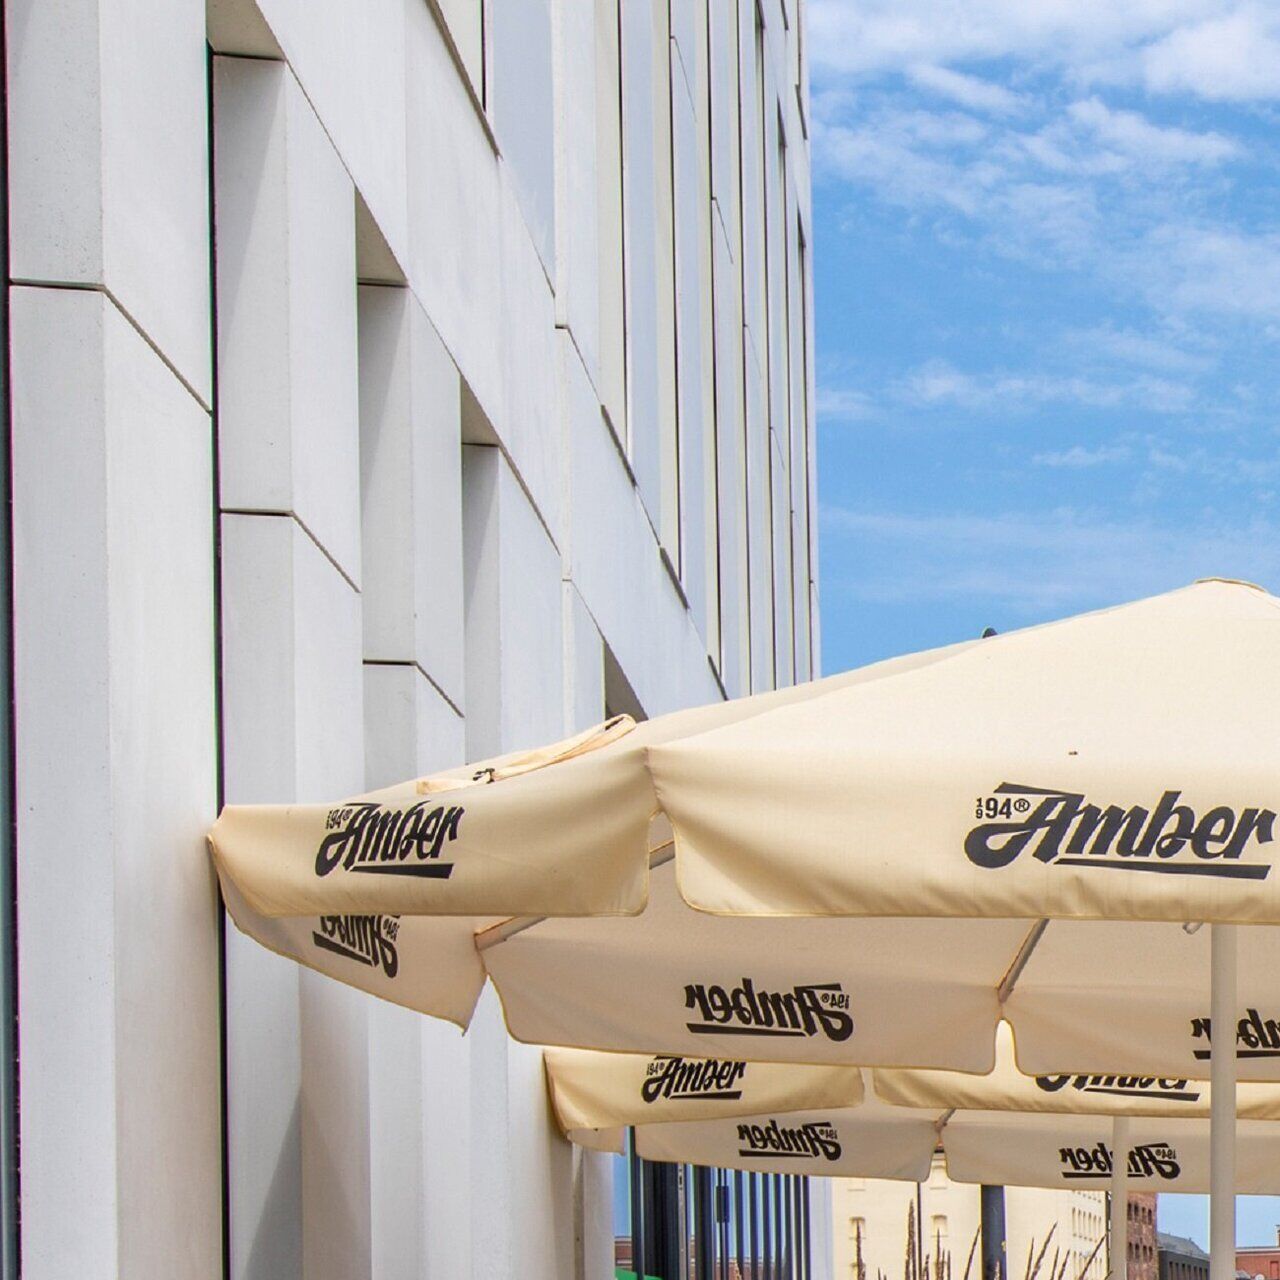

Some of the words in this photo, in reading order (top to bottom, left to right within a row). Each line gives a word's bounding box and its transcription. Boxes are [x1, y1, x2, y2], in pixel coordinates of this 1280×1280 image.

[314, 800, 465, 877] Amber
[963, 781, 1277, 869] Amber
[641, 1056, 747, 1103] Amber
